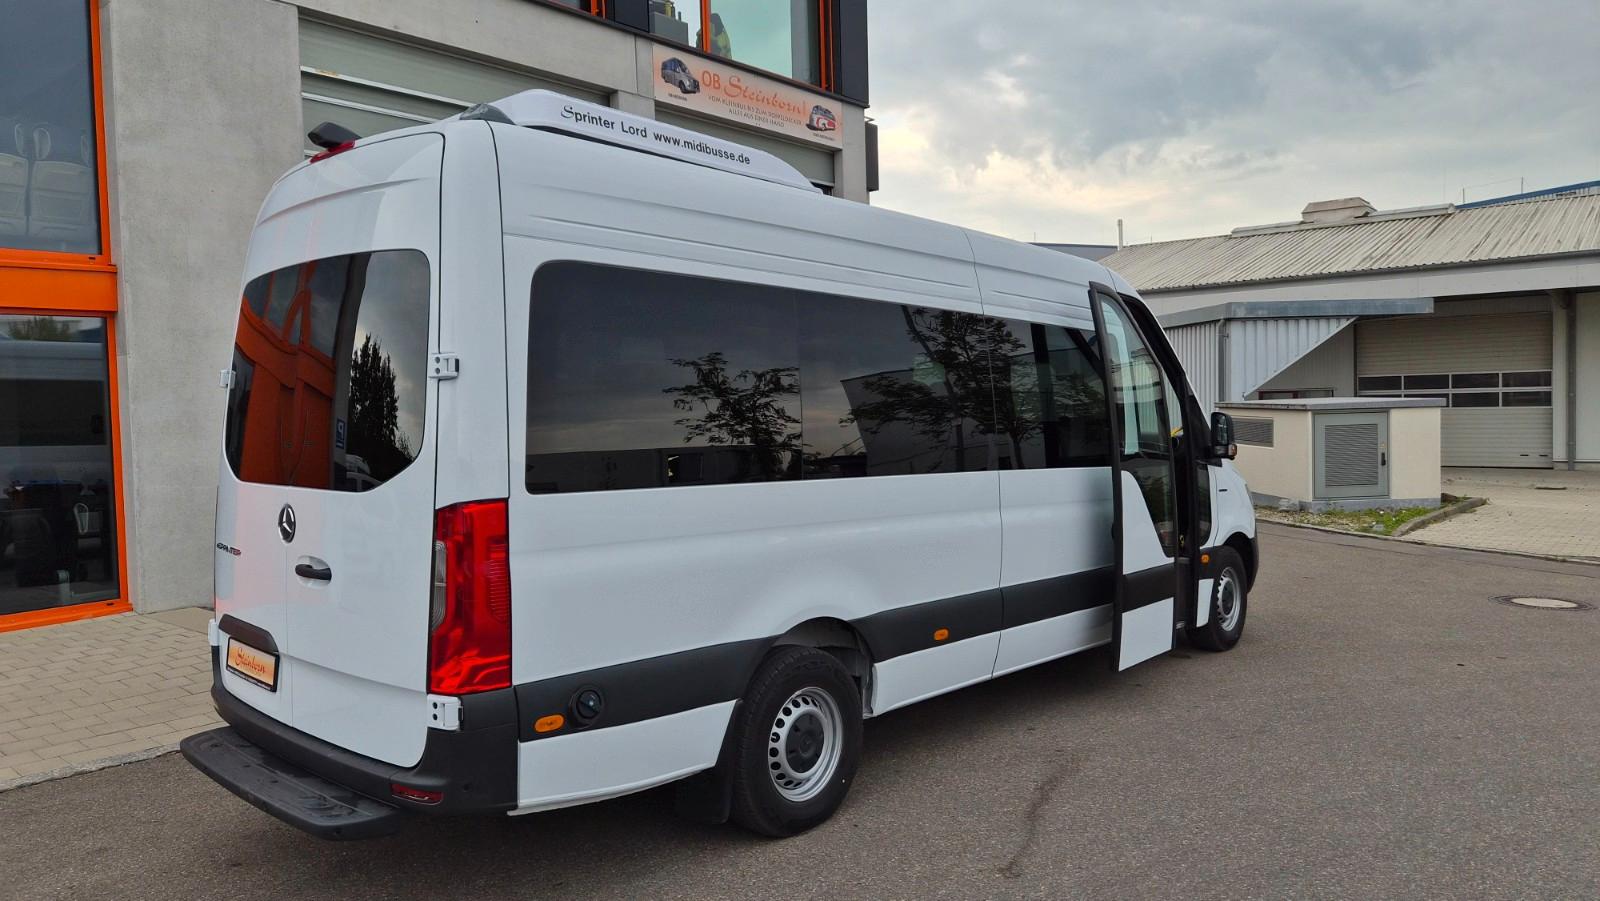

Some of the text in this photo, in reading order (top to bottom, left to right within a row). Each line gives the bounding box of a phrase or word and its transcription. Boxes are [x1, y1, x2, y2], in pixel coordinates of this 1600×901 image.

[702, 70, 721, 90] OB
[724, 75, 802, 114] Steinborn
[755, 106, 768, 116] ZUM
[560, 104, 751, 165] Sprinter Lord www.midibusse.de
